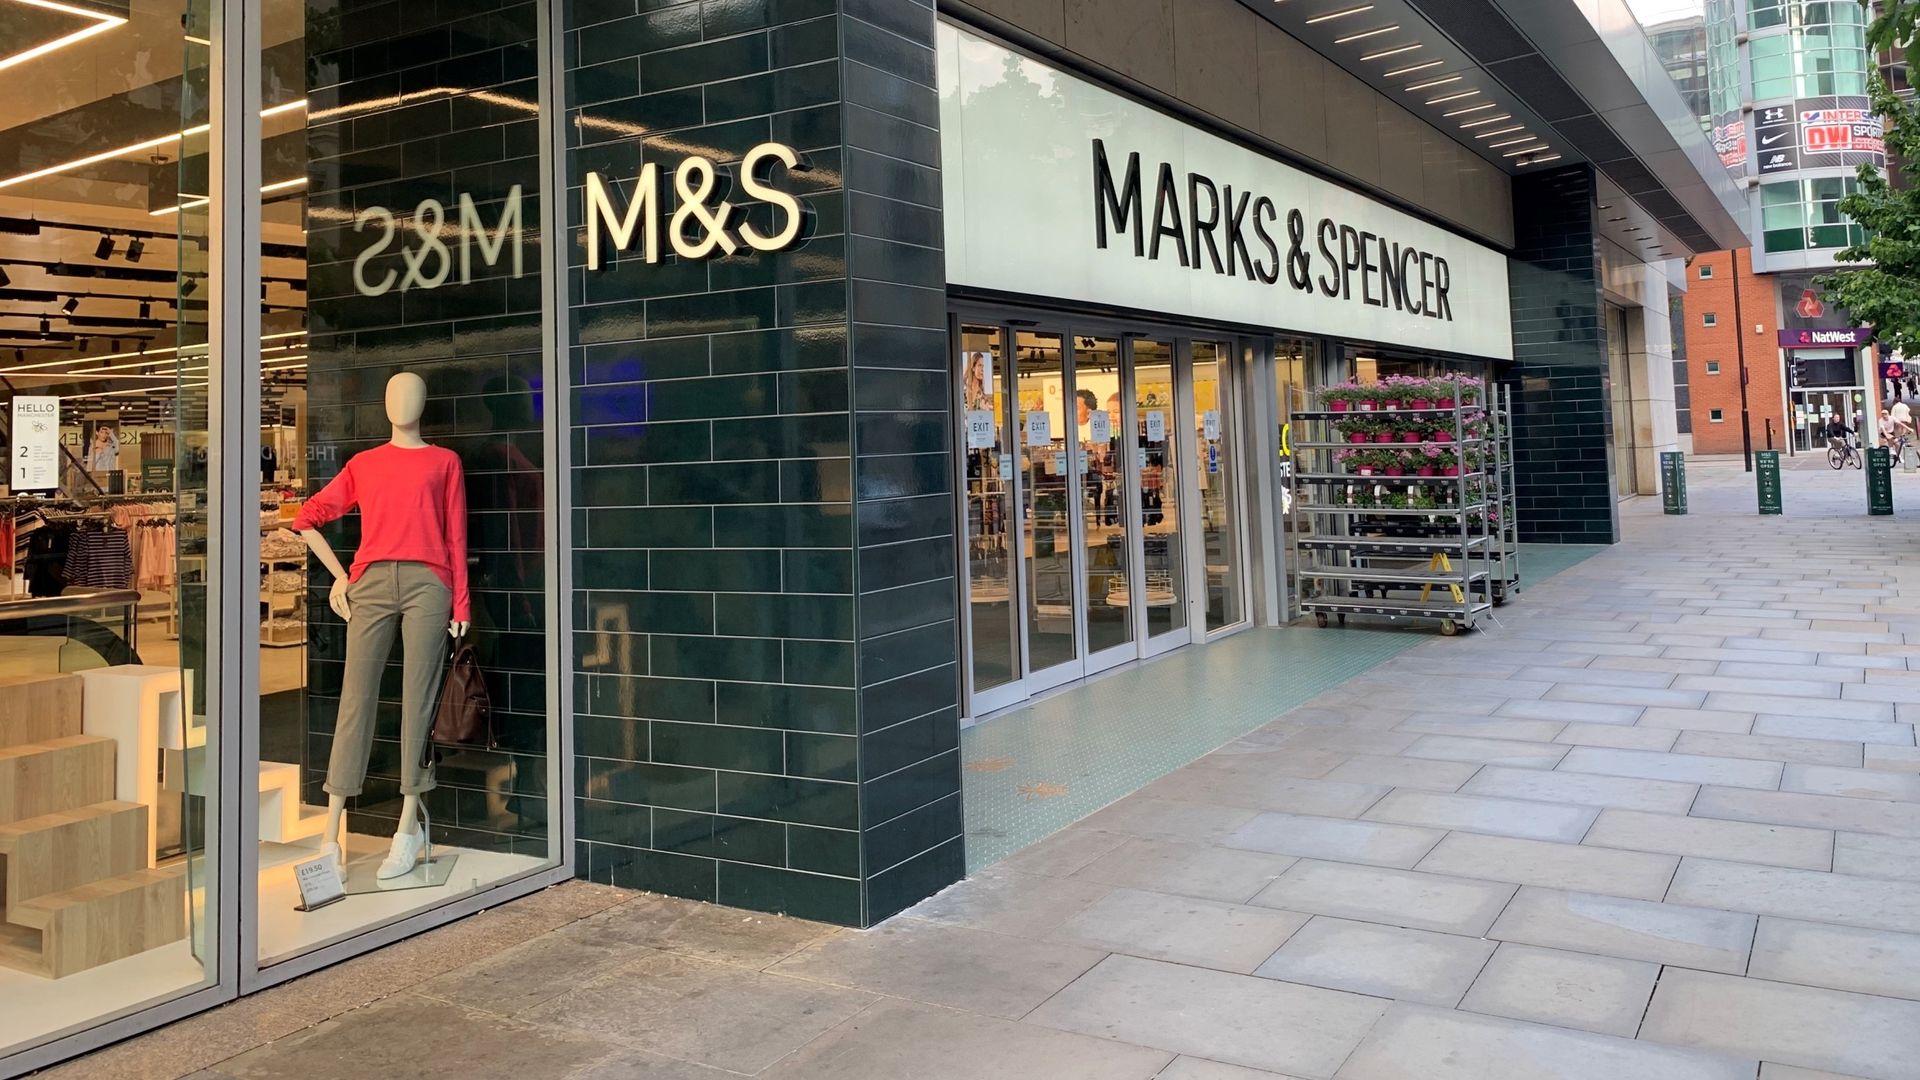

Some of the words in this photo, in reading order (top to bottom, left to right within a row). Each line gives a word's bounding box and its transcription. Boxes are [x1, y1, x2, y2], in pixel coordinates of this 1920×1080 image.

[586, 142, 806, 271] M&S
[1092, 138, 1279, 285] MARKS
[1286, 208, 1313, 293] &
[1318, 218, 1452, 321] SPENCER
[1811, 331, 1856, 343] NatWest
[18, 404, 55, 412] HELLO
[973, 422, 989, 432] EXIT
[1031, 422, 1045, 431] EXIT
[1094, 420, 1106, 429] EXIT
[20, 446, 28, 457] 2
[21, 467, 26, 479] 1
[301, 864, 323, 875] £19.50
